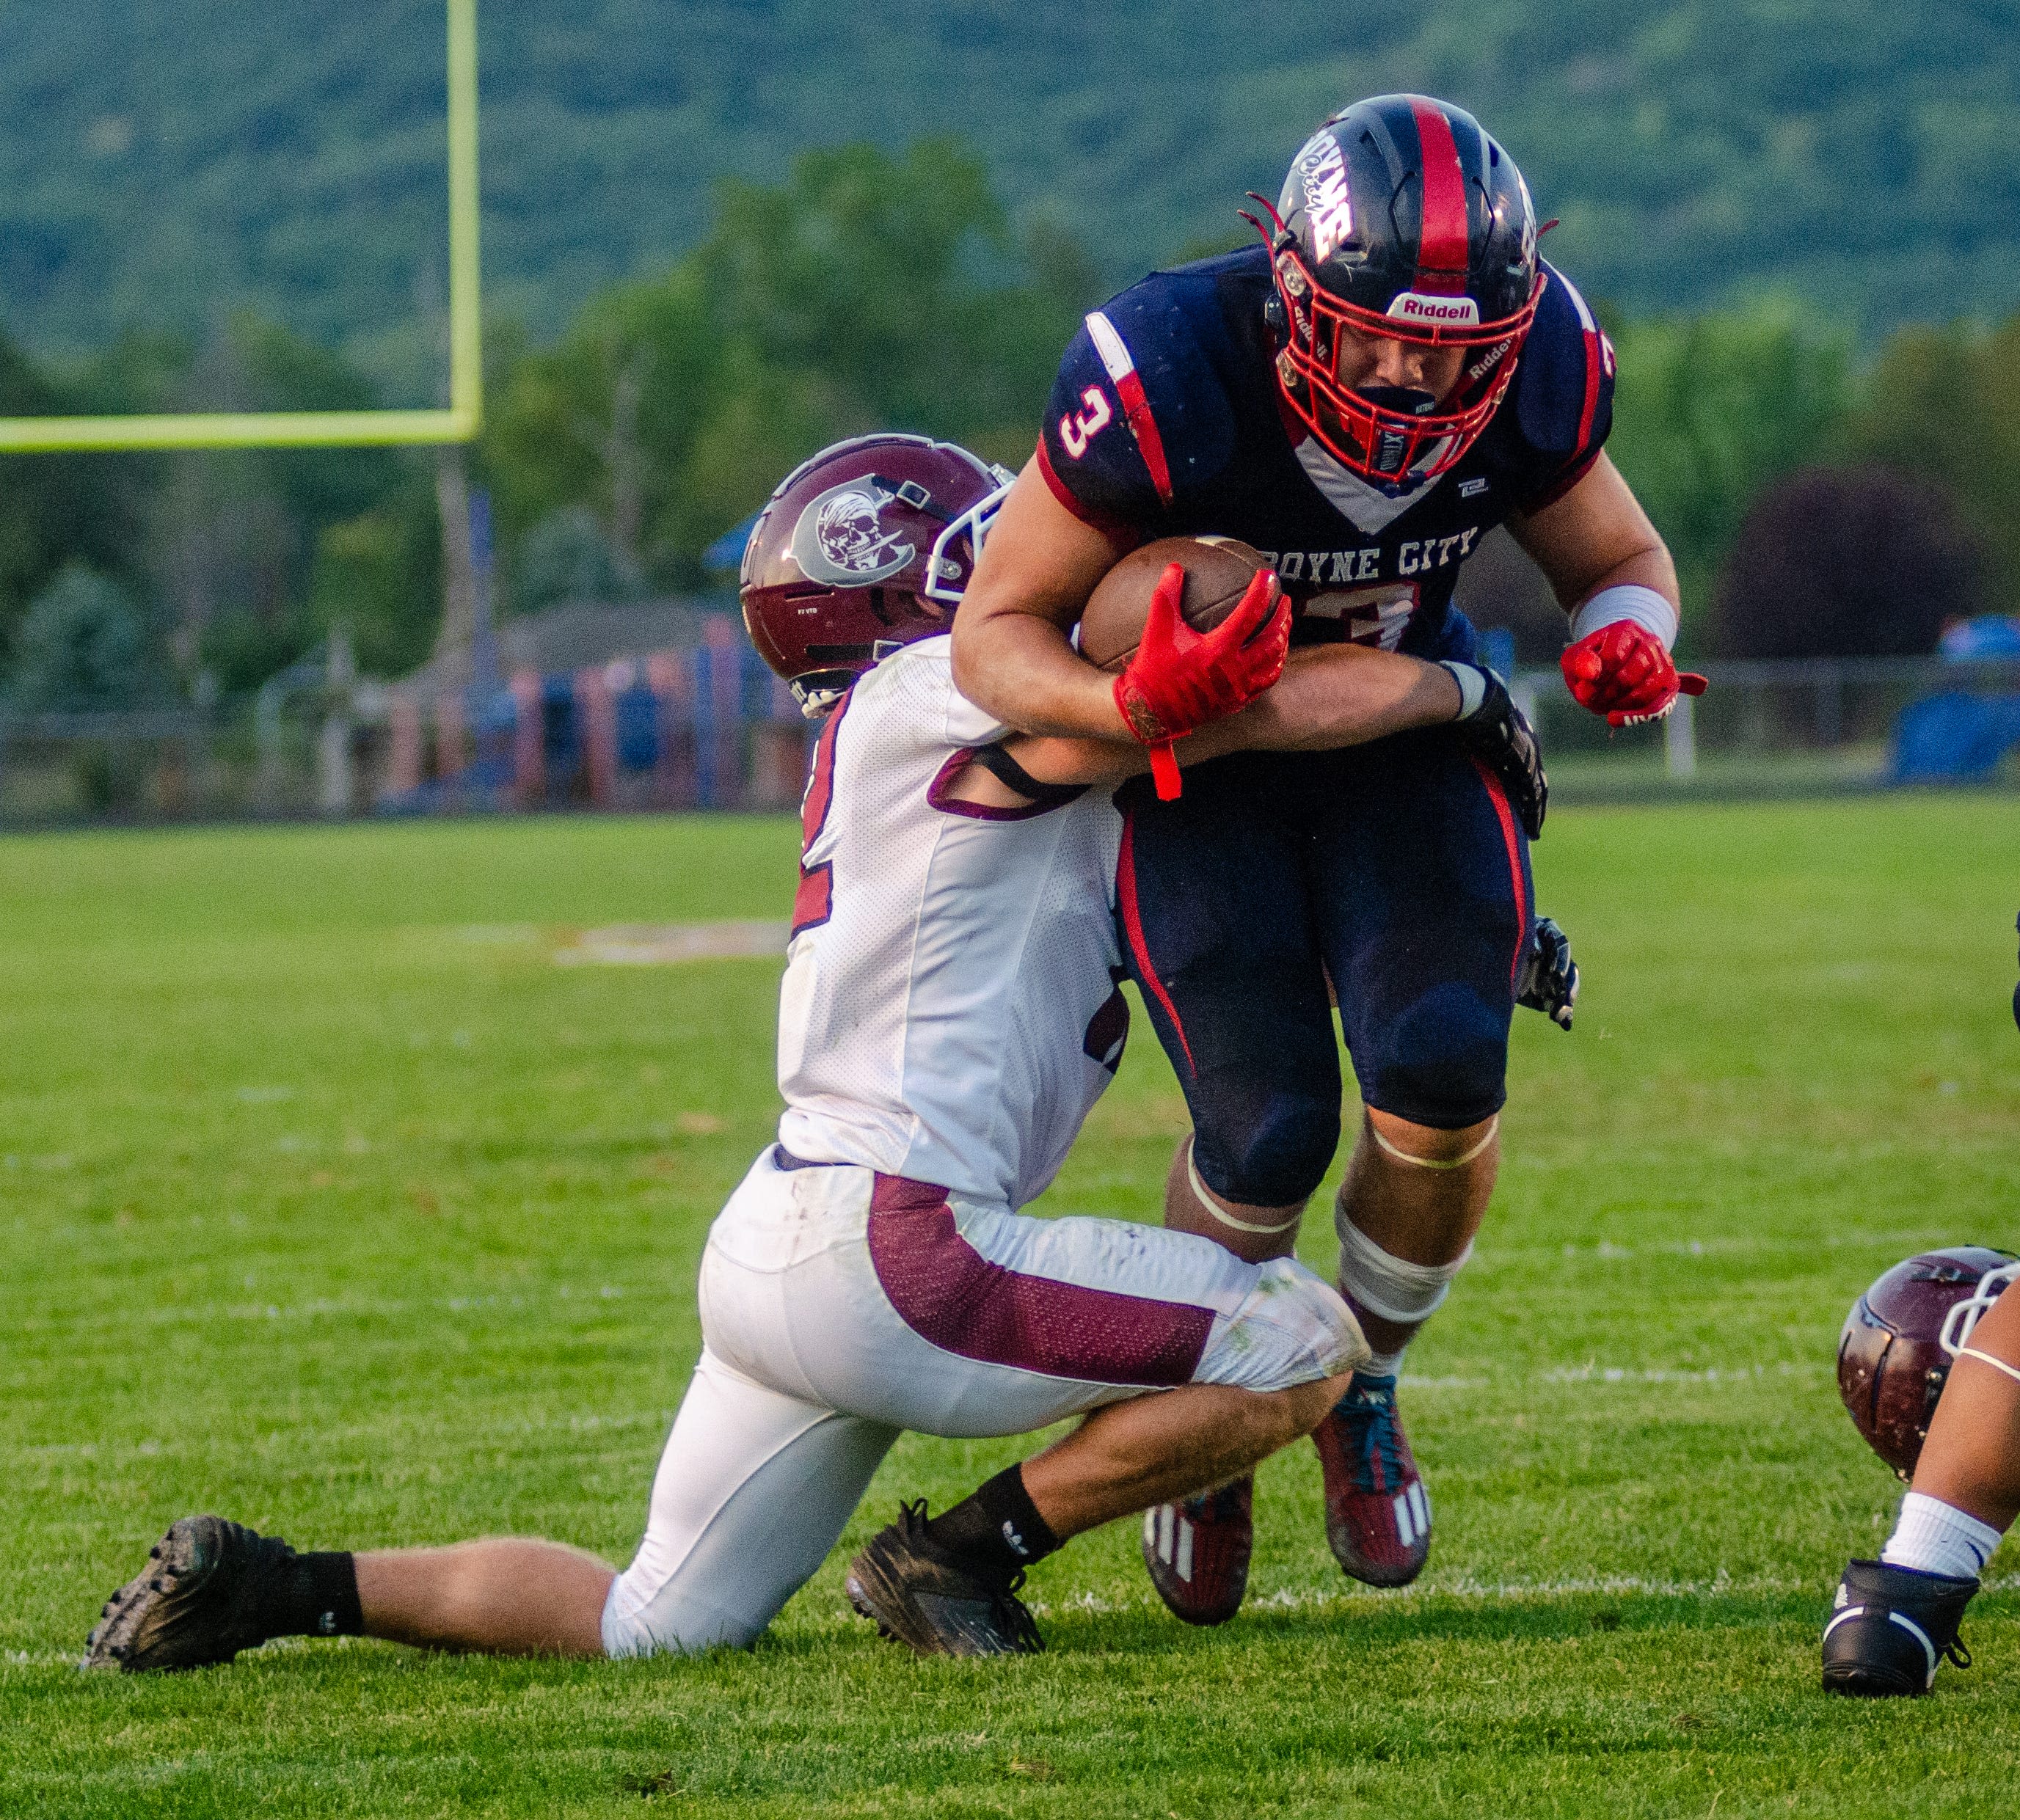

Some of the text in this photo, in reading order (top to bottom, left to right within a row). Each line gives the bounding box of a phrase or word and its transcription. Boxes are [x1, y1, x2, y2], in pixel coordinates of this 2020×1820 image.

[1294, 305, 1327, 359] Riddll
[1404, 299, 1471, 318] Riddell
[1059, 384, 1113, 461] 3
[1399, 527, 1478, 575] CITY
